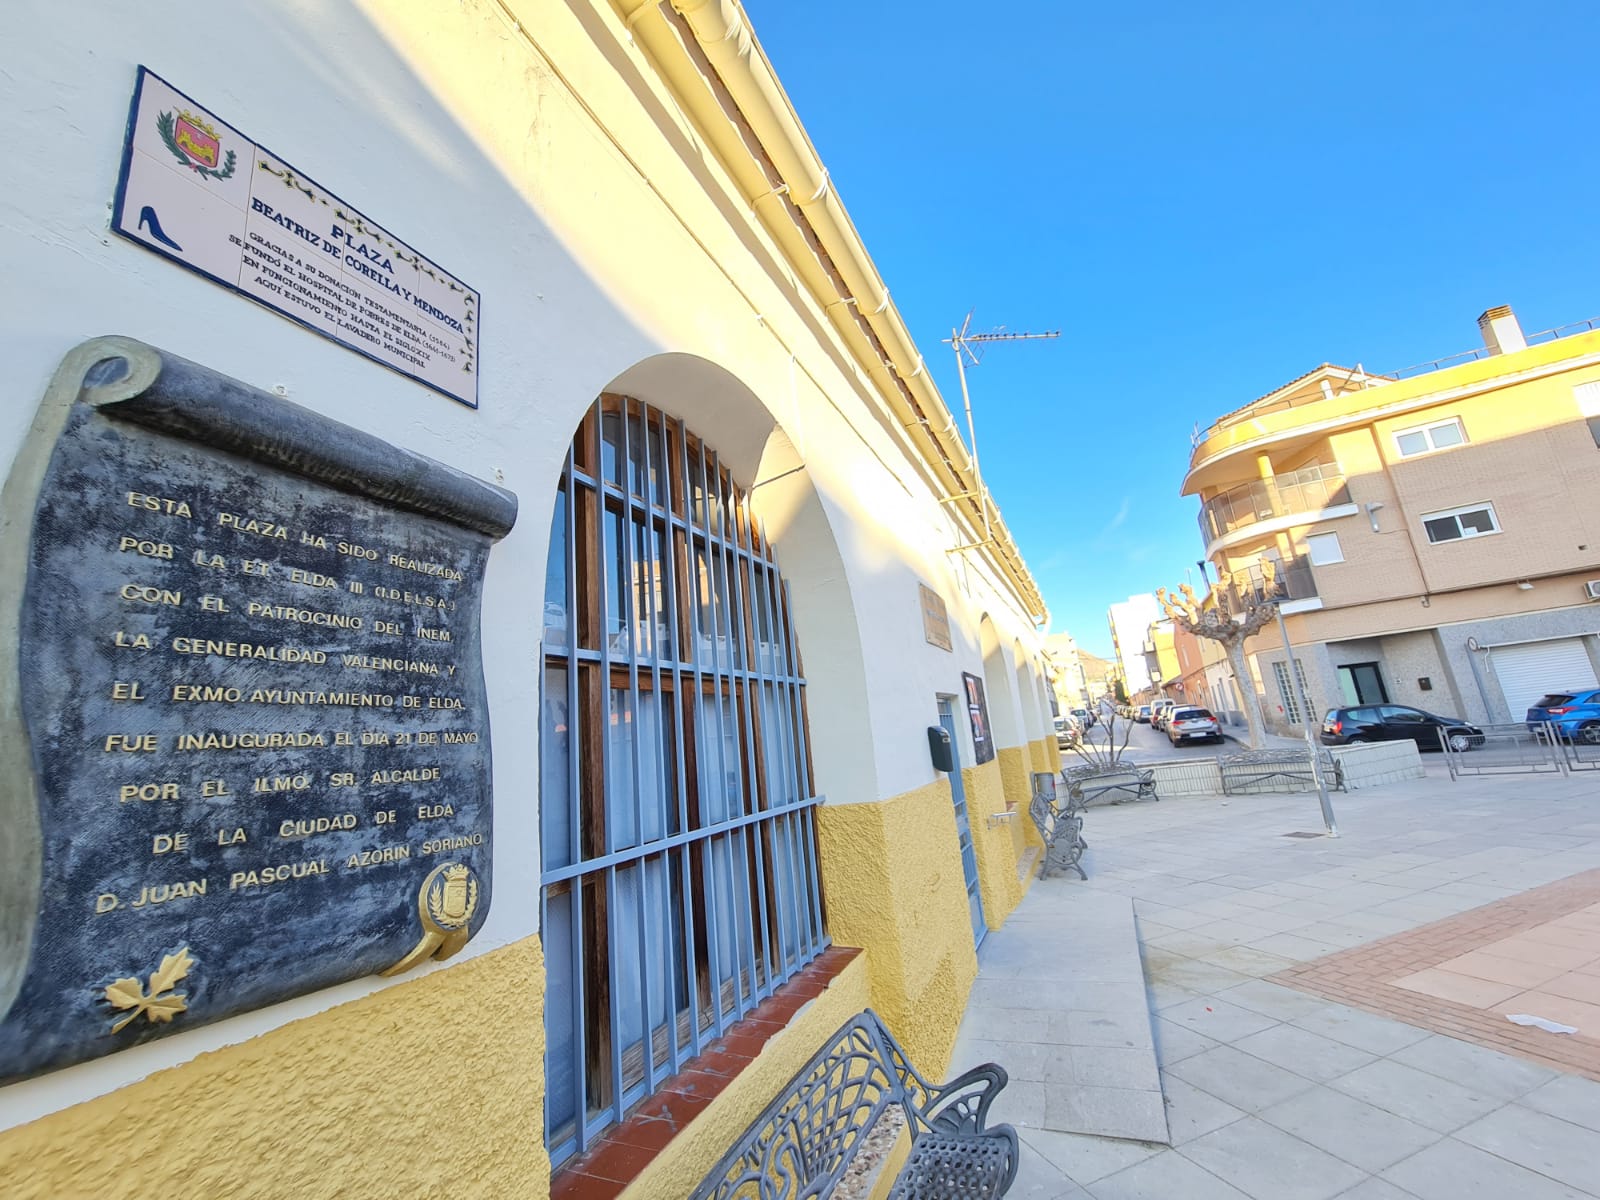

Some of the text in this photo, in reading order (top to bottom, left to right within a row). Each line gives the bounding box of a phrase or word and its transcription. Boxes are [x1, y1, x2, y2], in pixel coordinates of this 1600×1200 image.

[252, 197, 464, 334] BEATRIZ DE CORELLA Y MENDOZA
[331, 224, 394, 274] PLAZA
[228, 234, 242, 247] SE
[243, 242, 280, 267] FUNDÓ
[284, 264, 296, 276] EL
[298, 272, 344, 302] HOSPITAL
[346, 298, 358, 310] DE
[360, 307, 390, 327] POBRES
[392, 323, 402, 333] DE
[404, 330, 420, 344] ELDA
[242, 255, 260, 269] EN
[262, 265, 348, 316] FUNCIONAMIENTO
[351, 313, 380, 335] HASTA
[384, 331, 394, 341] EL
[250, 232, 294, 261] GRACIAS
[306, 264, 316, 273] SU
[364, 297, 427, 337] TESTAMENTARIA
[254, 276, 426, 368] AQUÍ ESTUVO EL LAVADERO MUNICIPAL
[119, 536, 174, 560] POR
[194, 549, 225, 570] LA
[242, 559, 270, 577] ET
[290, 569, 337, 590] ELDA
[350, 581, 364, 594] III
[126, 492, 463, 582] ESTA PLAZA HA SIDO REALIZADA
[120, 584, 183, 607] CON
[200, 595, 230, 614] EL
[248, 602, 362, 630] PATROCINIO
[375, 620, 404, 636] DEL
[114, 630, 456, 676] LA GENERALIDAD VALENCIANA Y
[112, 683, 145, 700] EL
[172, 685, 245, 703] EXMO.
[250, 689, 394, 708] AYUNTAMIENTO
[402, 696, 422, 709] DE
[105, 734, 158, 752] FUE
[178, 732, 325, 750] INAUGURADA
[335, 732, 354, 746] EL
[395, 732, 412, 746] 21
[418, 732, 438, 746] DE
[444, 732, 479, 744] MAYO
[120, 783, 180, 804] POR
[202, 778, 230, 798] EL
[371, 767, 441, 786] ALCALDE
[152, 804, 454, 854] DE LA CIUDAD DE ELDA
[96, 833, 484, 915] D. JUAN PASCUAL AZORIN SORIANO
